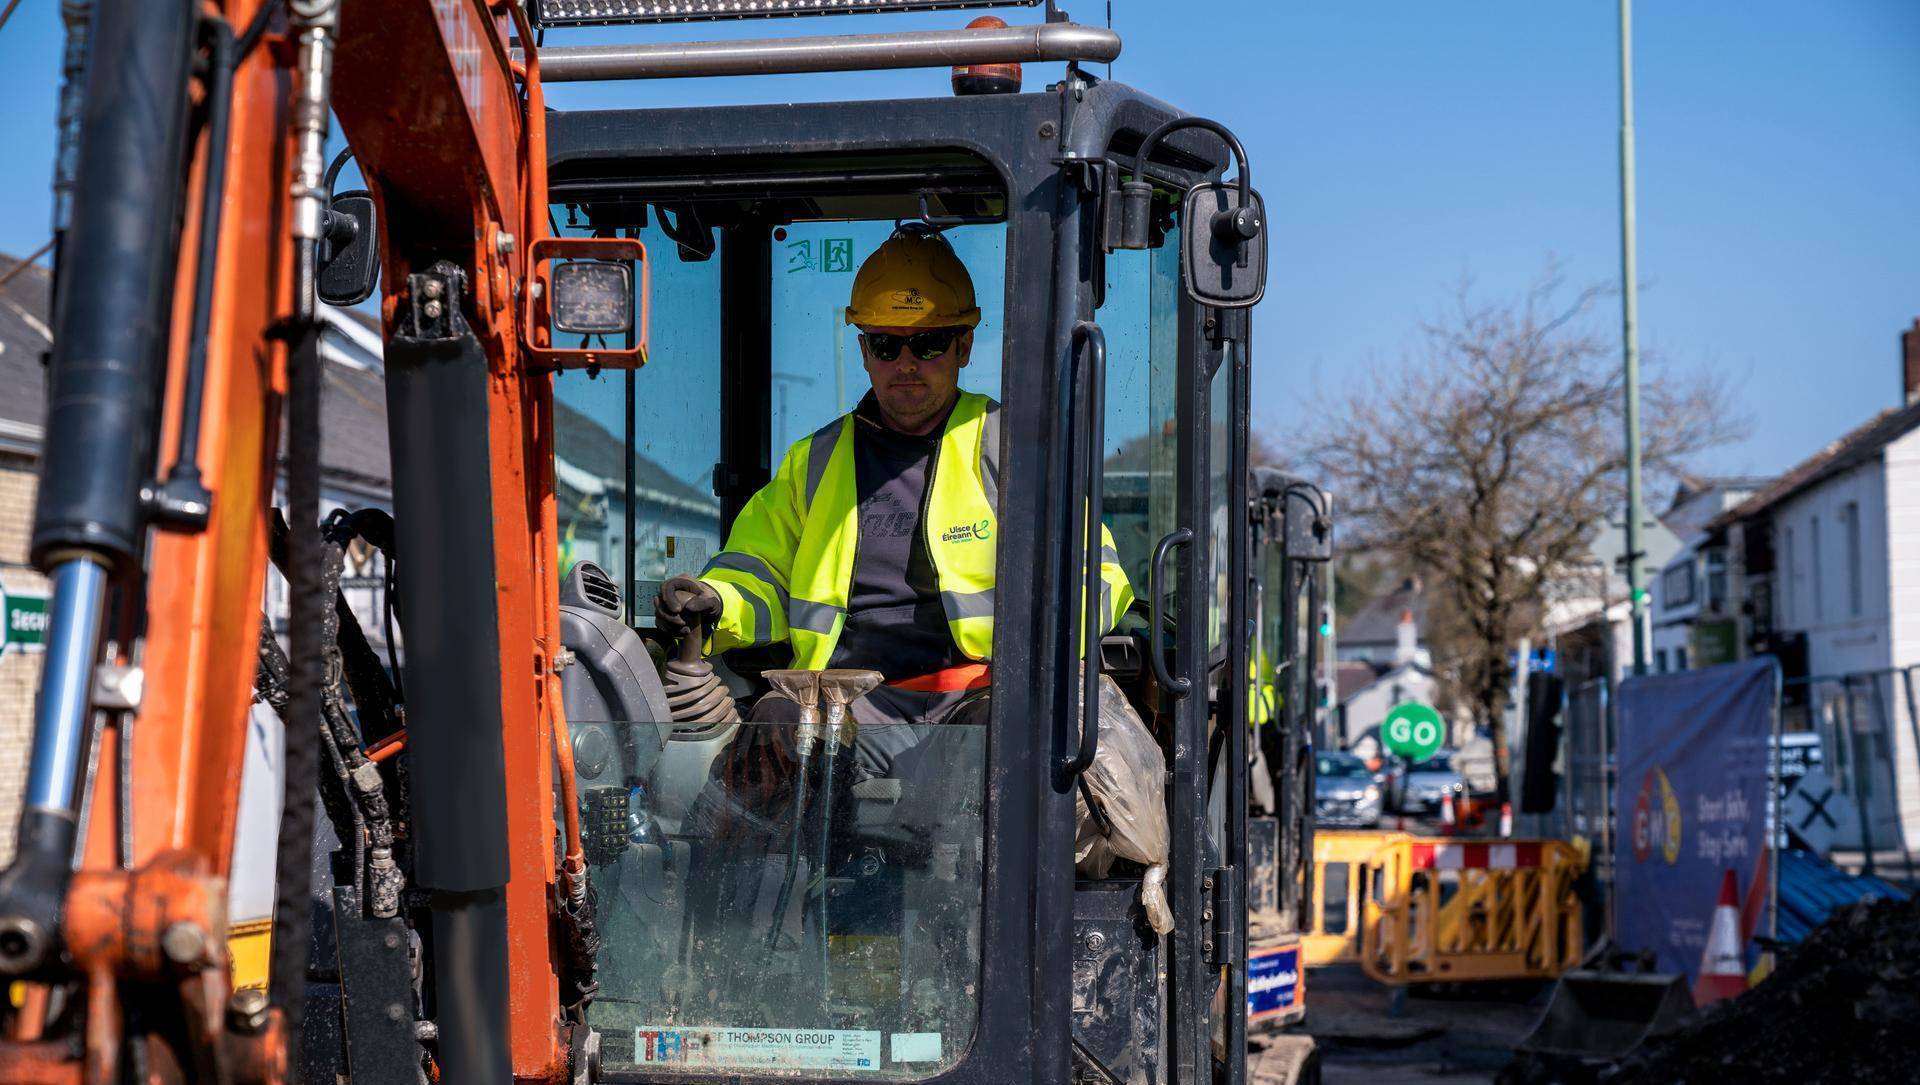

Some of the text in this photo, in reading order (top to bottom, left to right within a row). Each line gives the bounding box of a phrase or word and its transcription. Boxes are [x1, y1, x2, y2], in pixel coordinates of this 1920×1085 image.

[949, 525, 971, 533] Uisce
[943, 531, 972, 541] Éireann
[1390, 717, 1437, 746] GO
[727, 1032, 792, 1044] THOMPSON
[795, 1034, 835, 1045] GROUP
